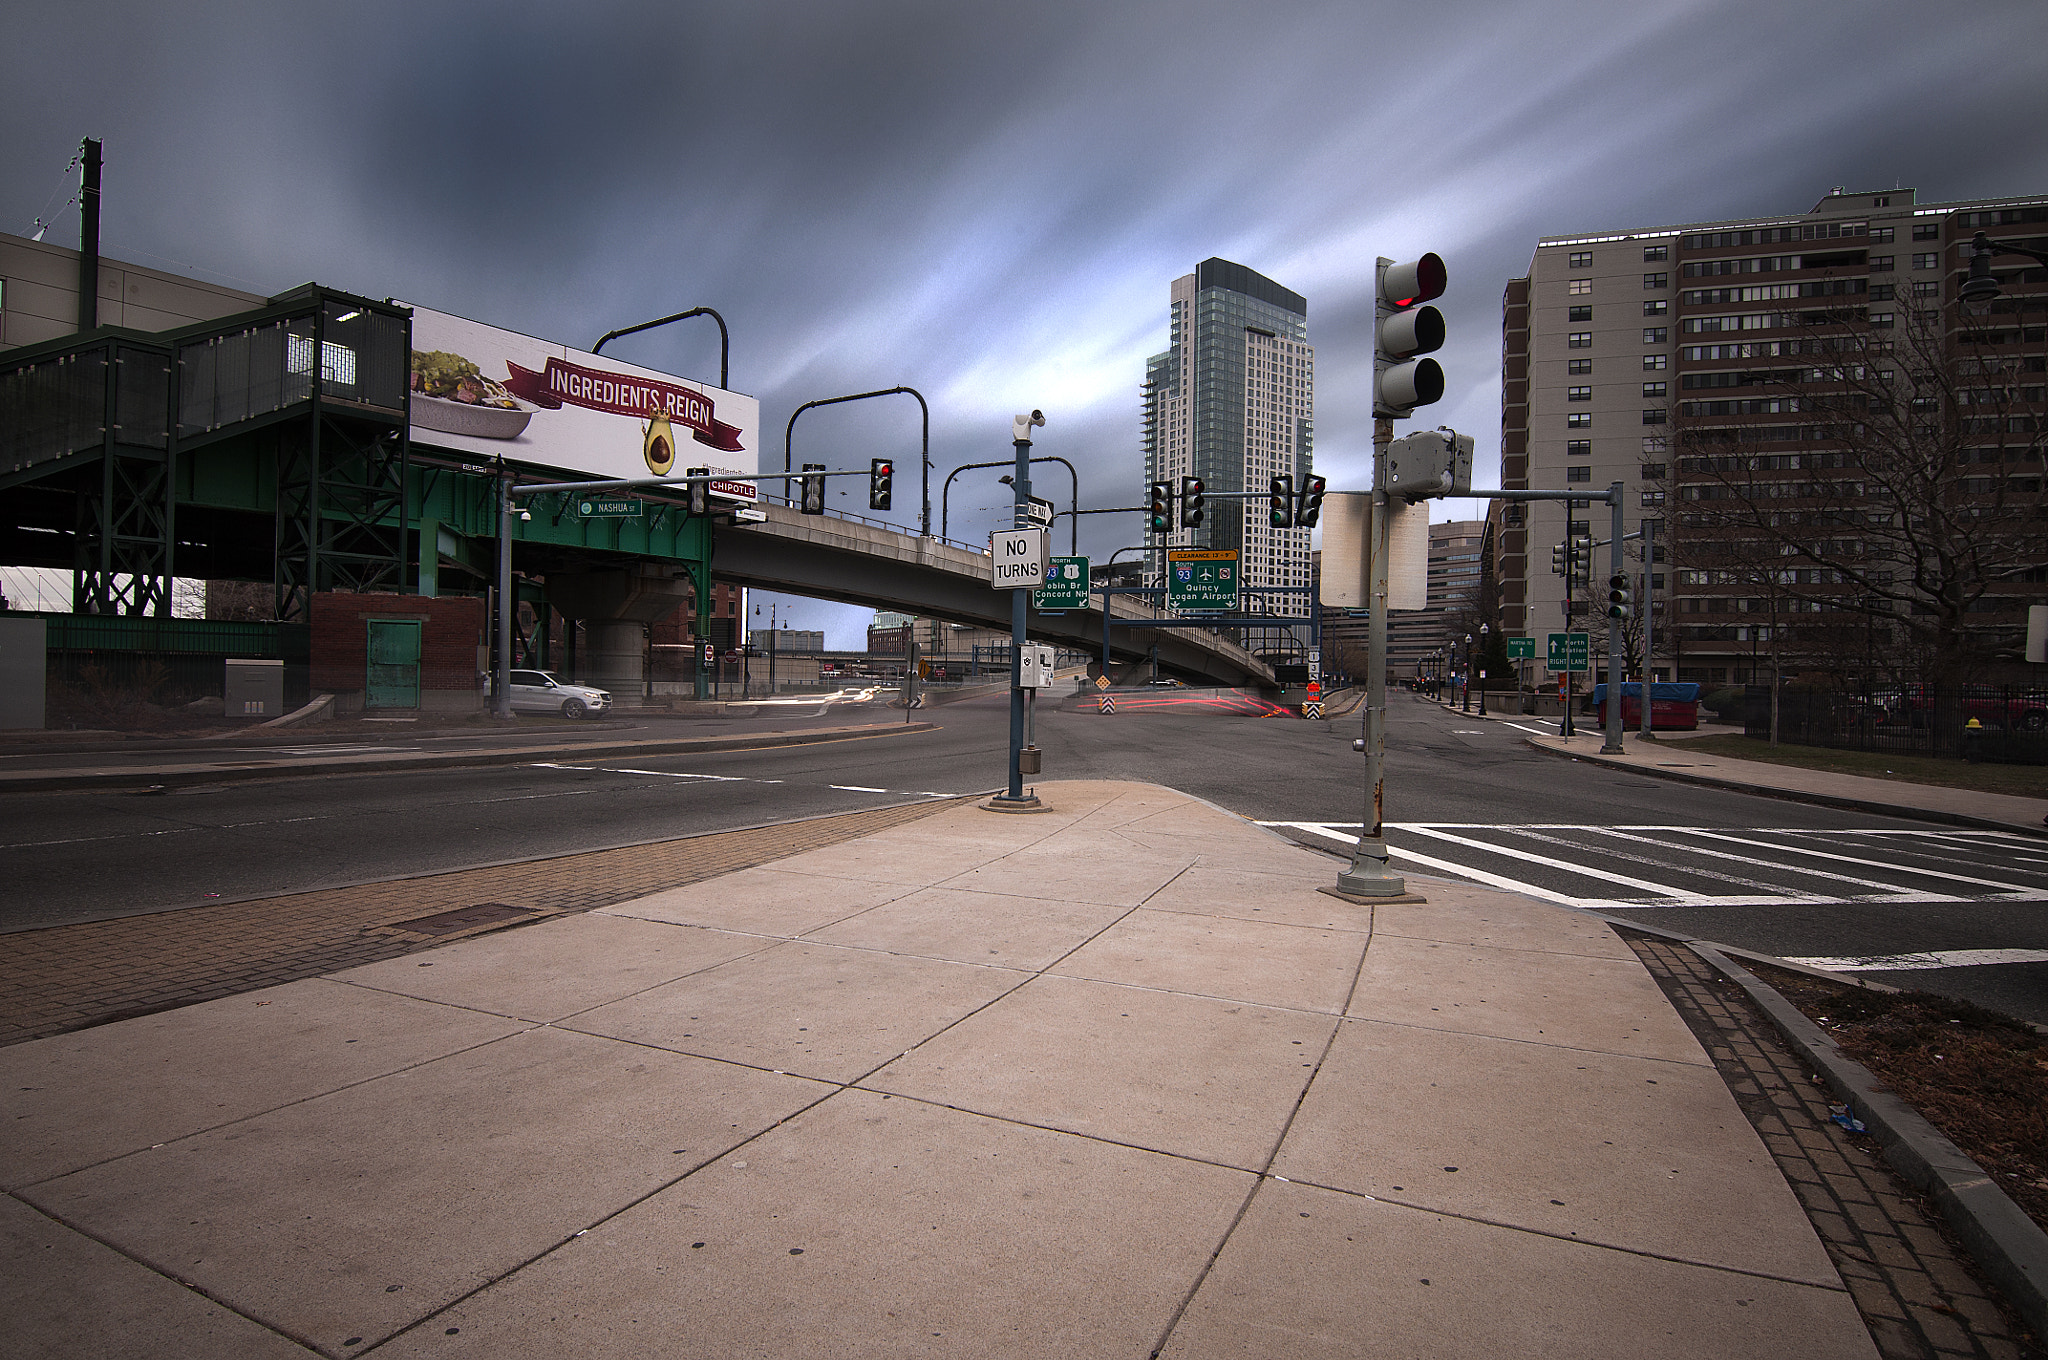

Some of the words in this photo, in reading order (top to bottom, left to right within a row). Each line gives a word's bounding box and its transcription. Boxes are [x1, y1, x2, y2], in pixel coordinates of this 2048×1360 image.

[550, 367, 660, 410] INGREDIENTS
[666, 392, 710, 427] REIGN
[711, 481, 755, 496] CHIPOTLE
[598, 503, 628, 512] NASHUA
[1028, 503, 1037, 515] ONE
[1006, 539, 1027, 556] NO
[997, 562, 1039, 578] TURNS
[1178, 570, 1190, 579] 93
[1186, 584, 1219, 592] Quincy
[1035, 590, 1071, 598] Concord
[1075, 590, 1088, 598] NH
[1170, 593, 1197, 601] Logan
[1202, 592, 1236, 601] Airport
